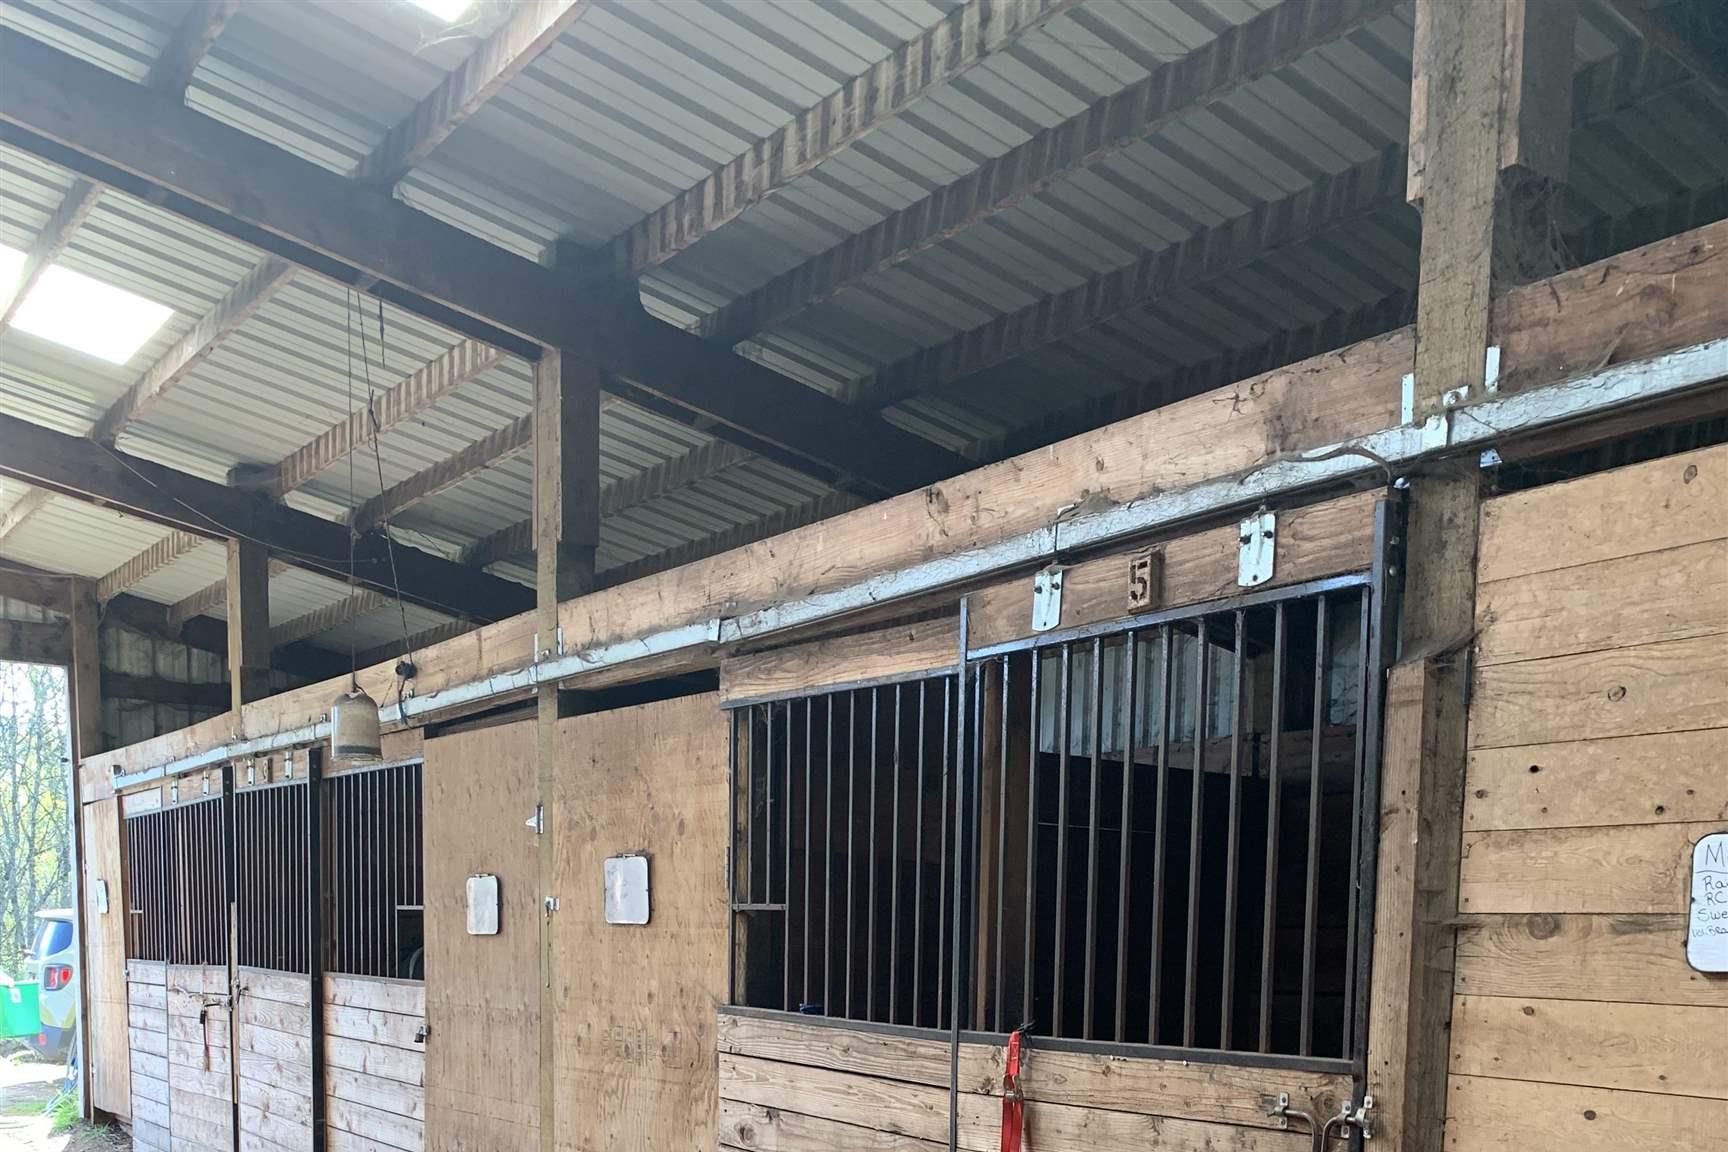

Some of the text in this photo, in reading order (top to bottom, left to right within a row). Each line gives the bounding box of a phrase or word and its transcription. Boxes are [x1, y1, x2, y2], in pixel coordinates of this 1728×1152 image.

[1130, 561, 1148, 601] 5
[1705, 841, 1728, 868] M
[1702, 875, 1728, 891] Ra
[1697, 908, 1728, 921] Swe
